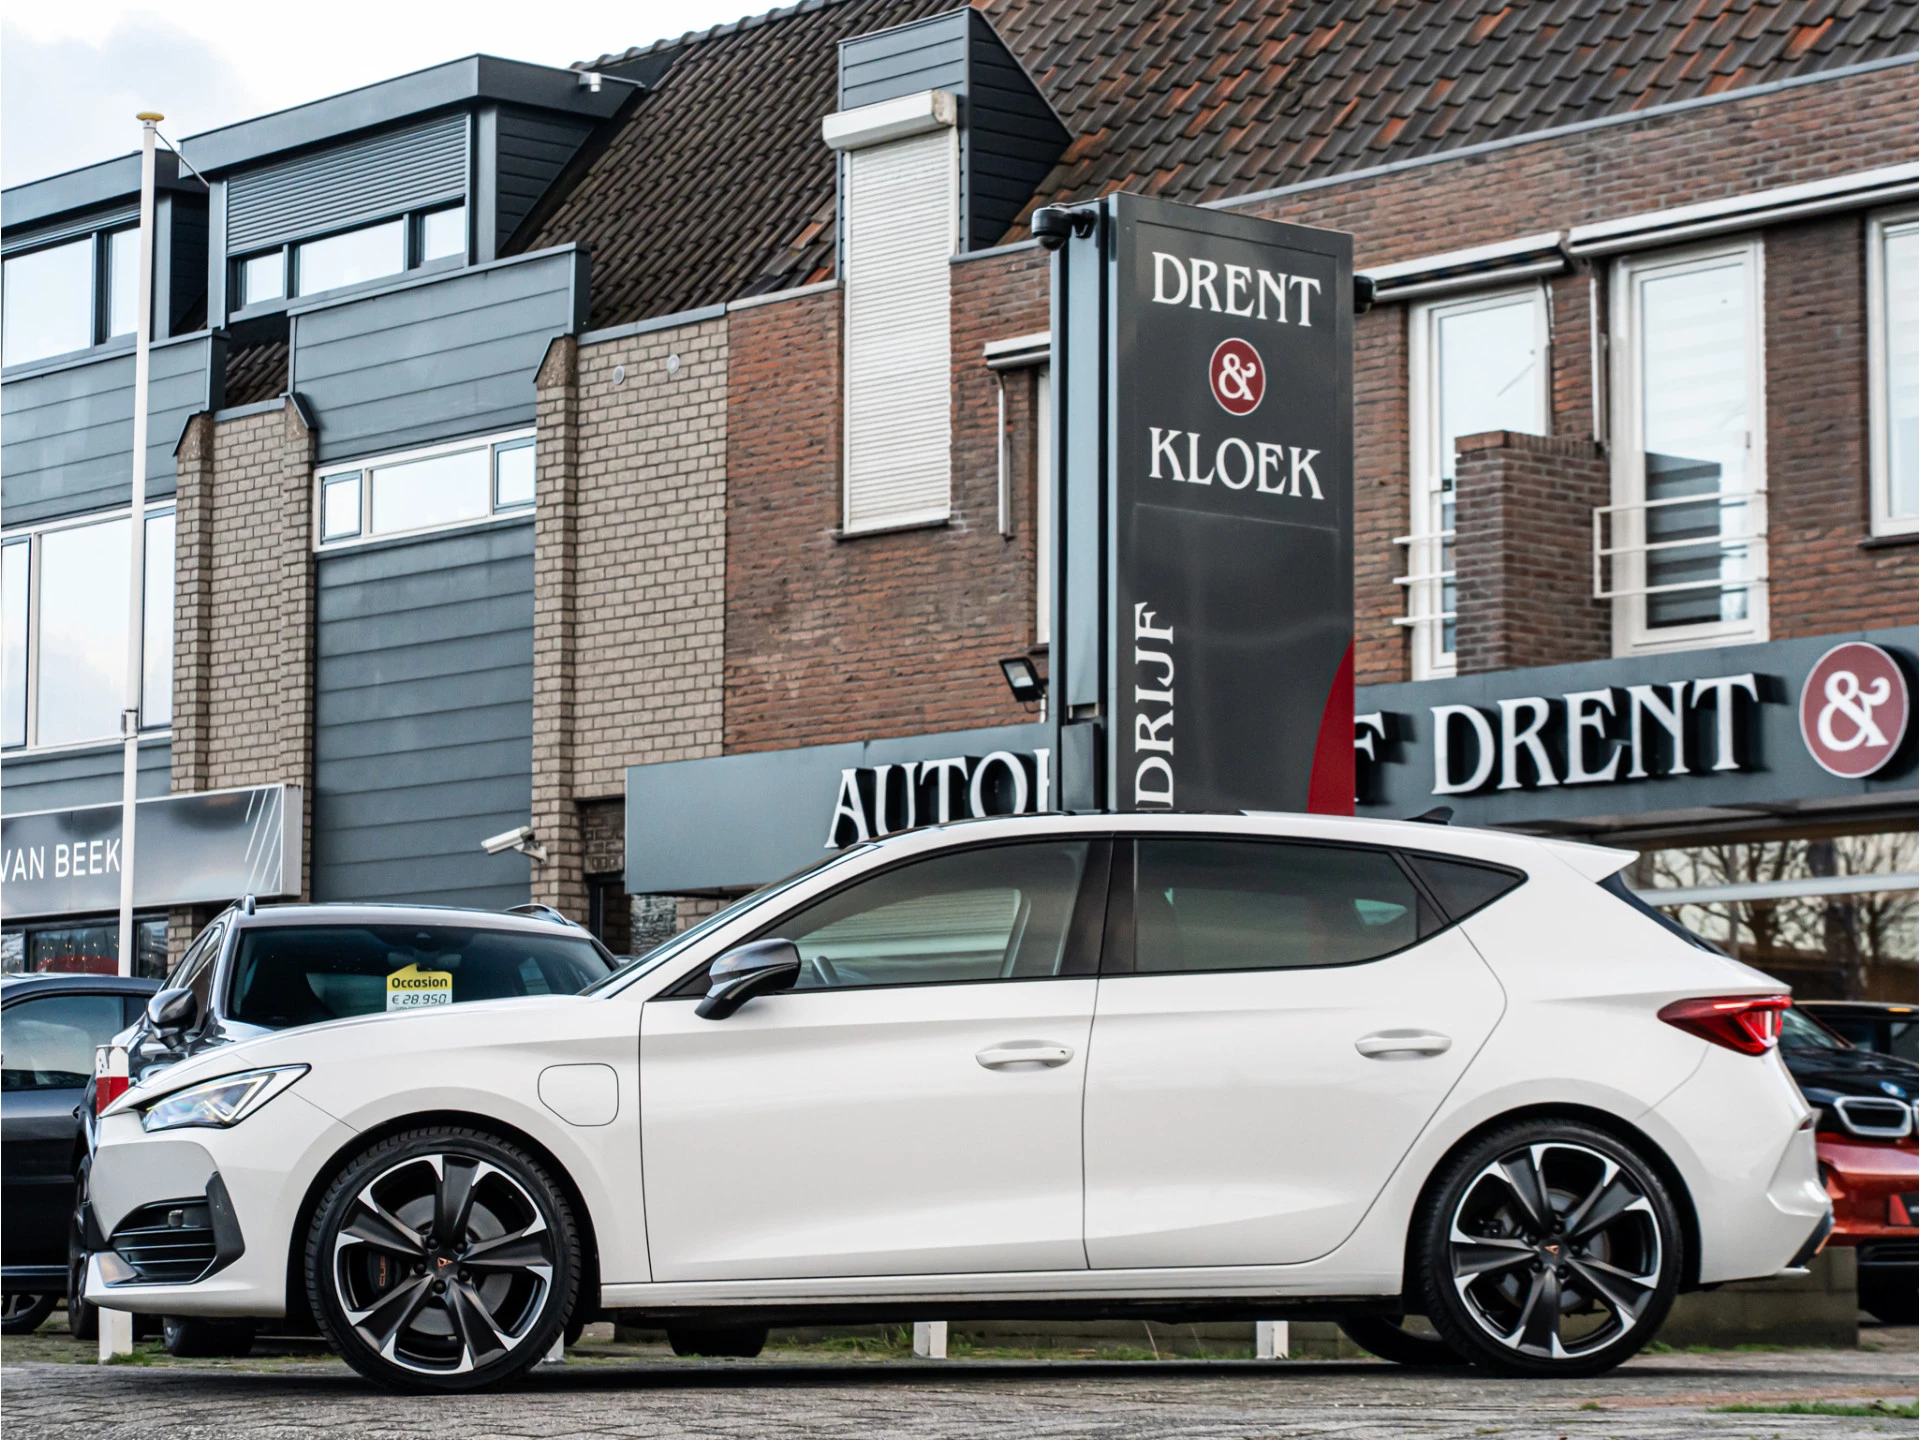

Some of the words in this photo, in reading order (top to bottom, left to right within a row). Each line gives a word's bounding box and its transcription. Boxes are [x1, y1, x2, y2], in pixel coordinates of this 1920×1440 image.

[1152, 251, 1321, 327] DRENT
[1218, 353, 1256, 401] &
[1149, 426, 1324, 500] KLOEK
[1134, 601, 1174, 811] DRIJF
[1430, 673, 1759, 795] DRENT
[1817, 670, 1891, 752] &
[1, 845, 45, 883] VAN
[55, 838, 121, 878] BEEK
[391, 976, 448, 989] Occasion
[392, 994, 400, 1005] €
[402, 993, 447, 1005] 28.950
